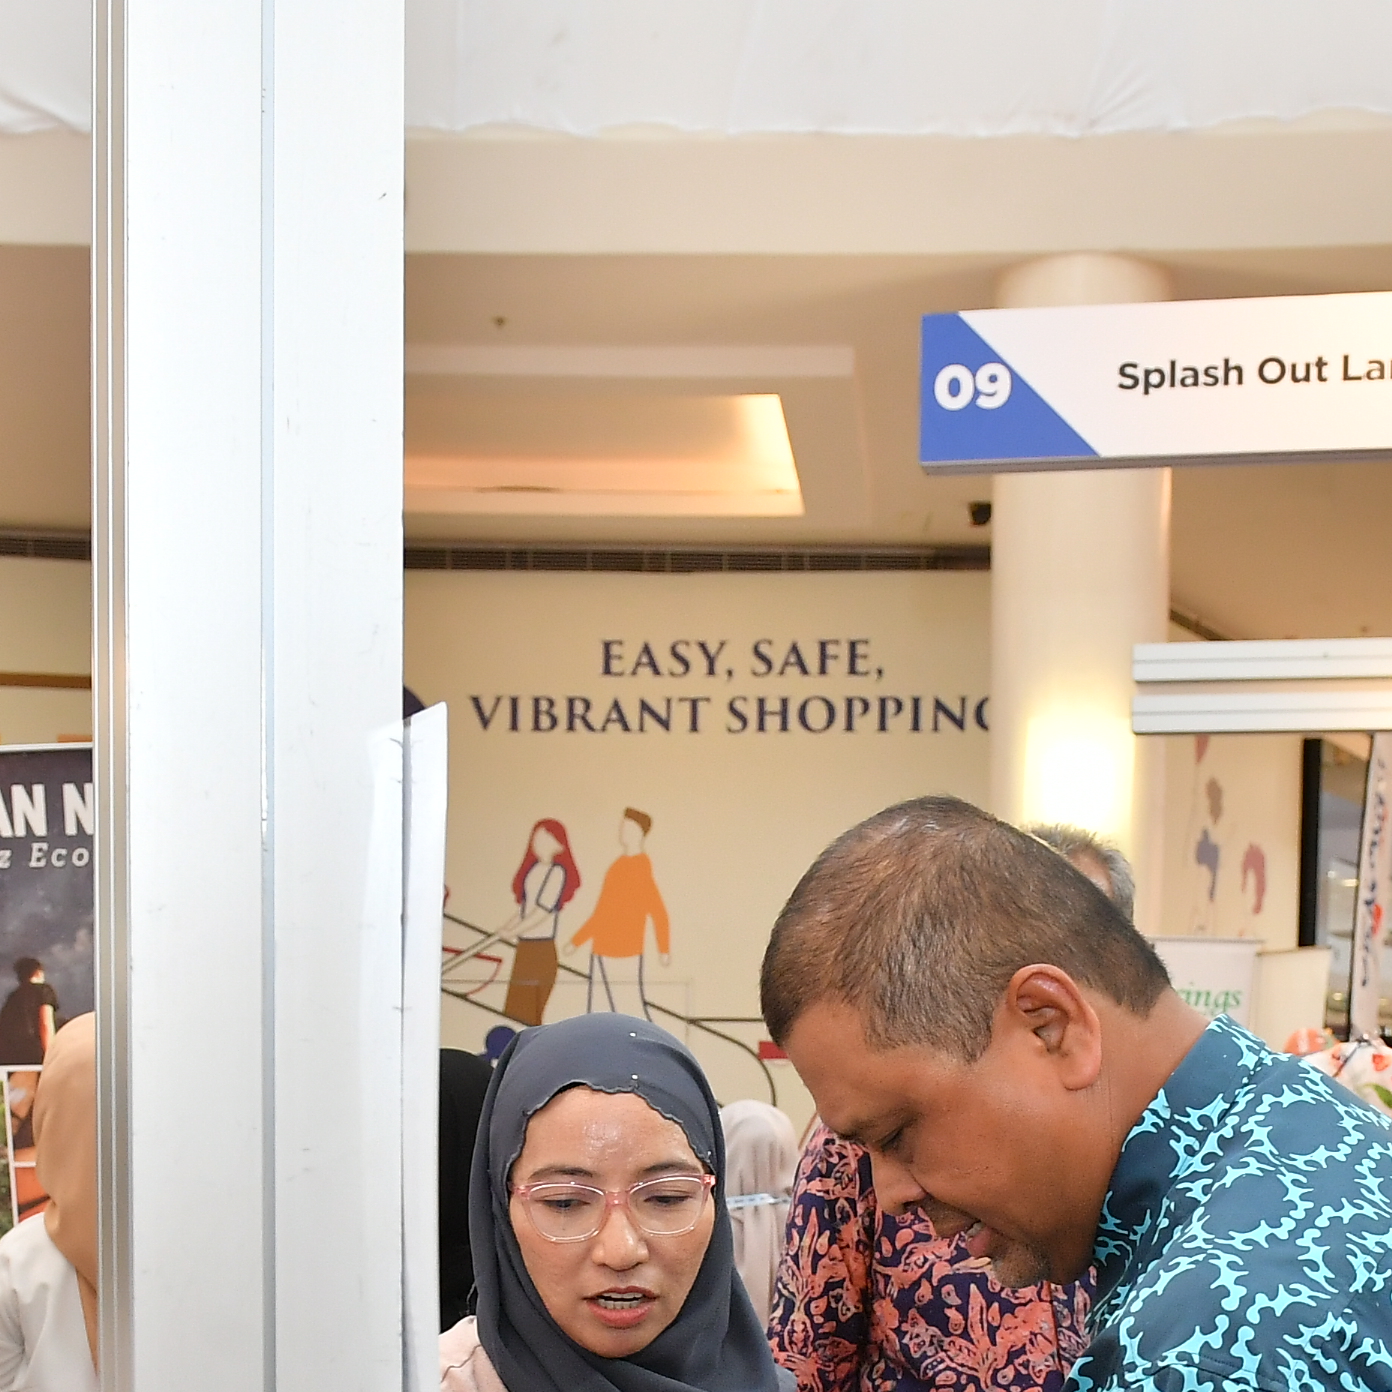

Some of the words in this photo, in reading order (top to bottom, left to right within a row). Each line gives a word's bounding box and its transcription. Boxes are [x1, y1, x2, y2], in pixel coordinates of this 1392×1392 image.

[933, 361, 1012, 411] 09
[1117, 357, 1245, 395] Splash
[1256, 355, 1330, 385] Out
[599, 637, 735, 683] EASY,
[750, 636, 885, 683] SAFE,
[469, 694, 712, 734] VIBRANT
